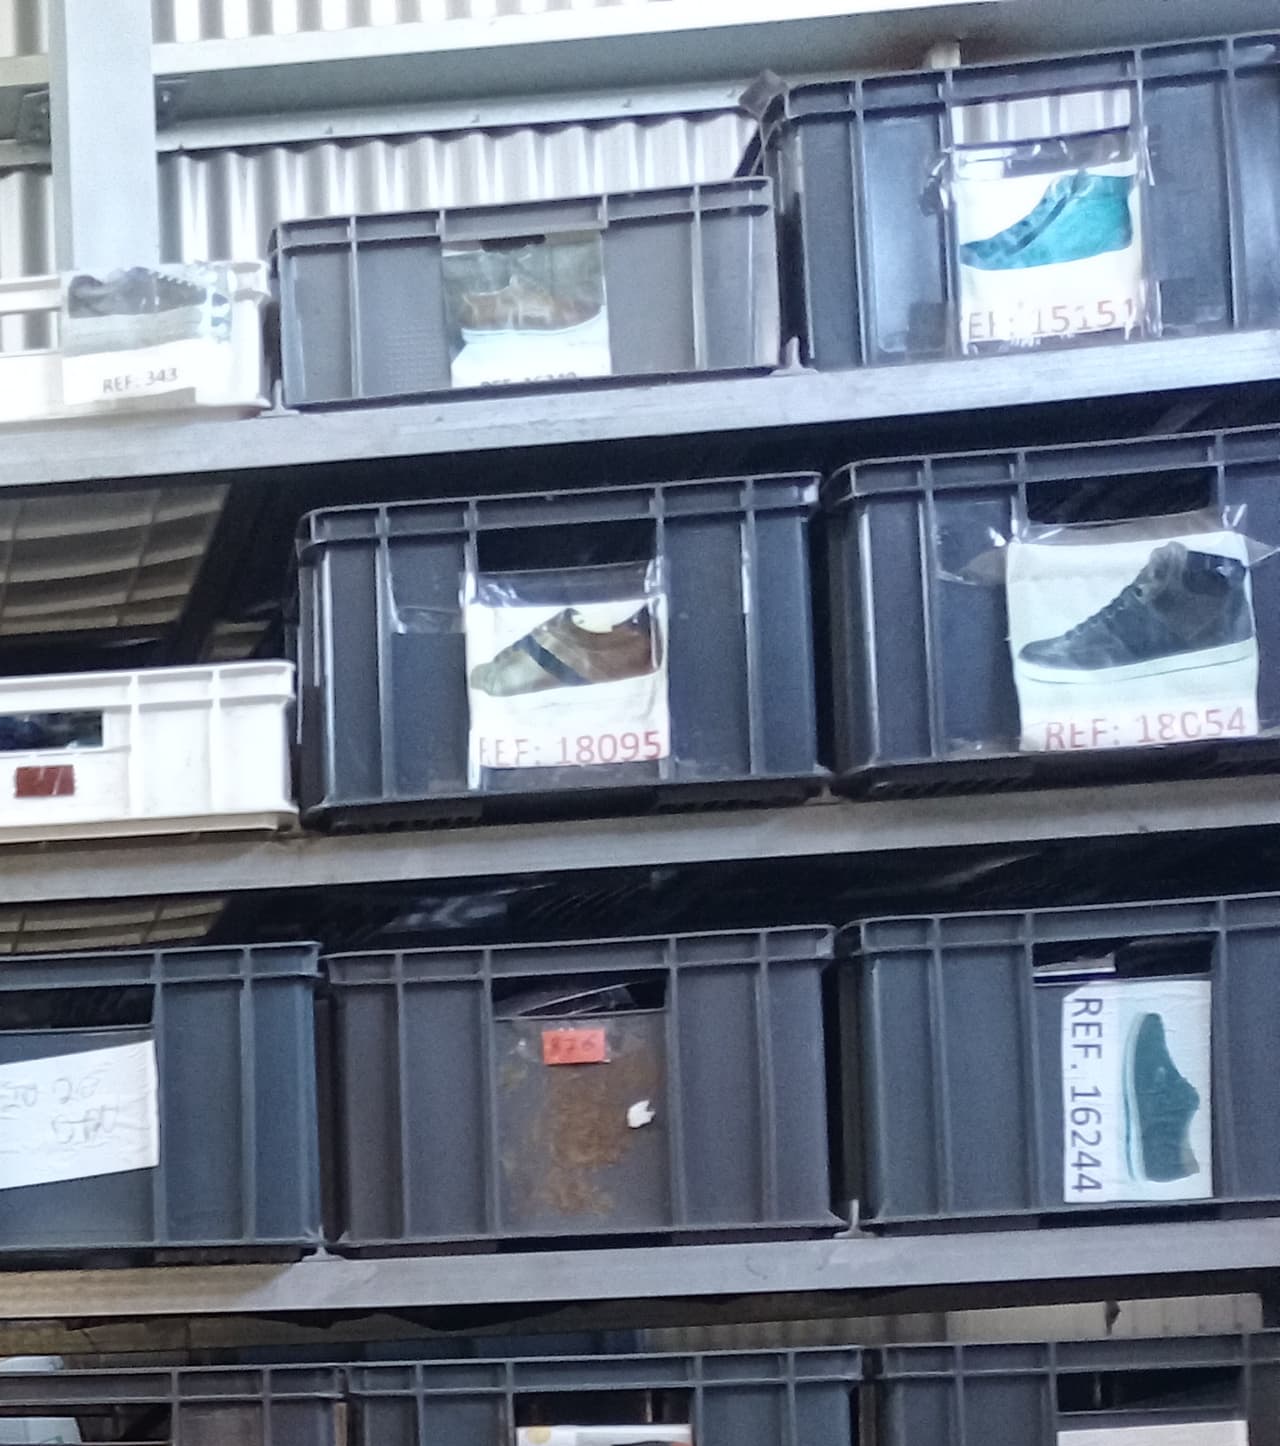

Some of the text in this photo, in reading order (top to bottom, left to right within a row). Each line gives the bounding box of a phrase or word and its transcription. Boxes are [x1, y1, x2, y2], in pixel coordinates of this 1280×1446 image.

[1136, 706, 1247, 744] 18054
[559, 730, 662, 765] 18095
[1070, 998, 1104, 1193] REF. 16244
